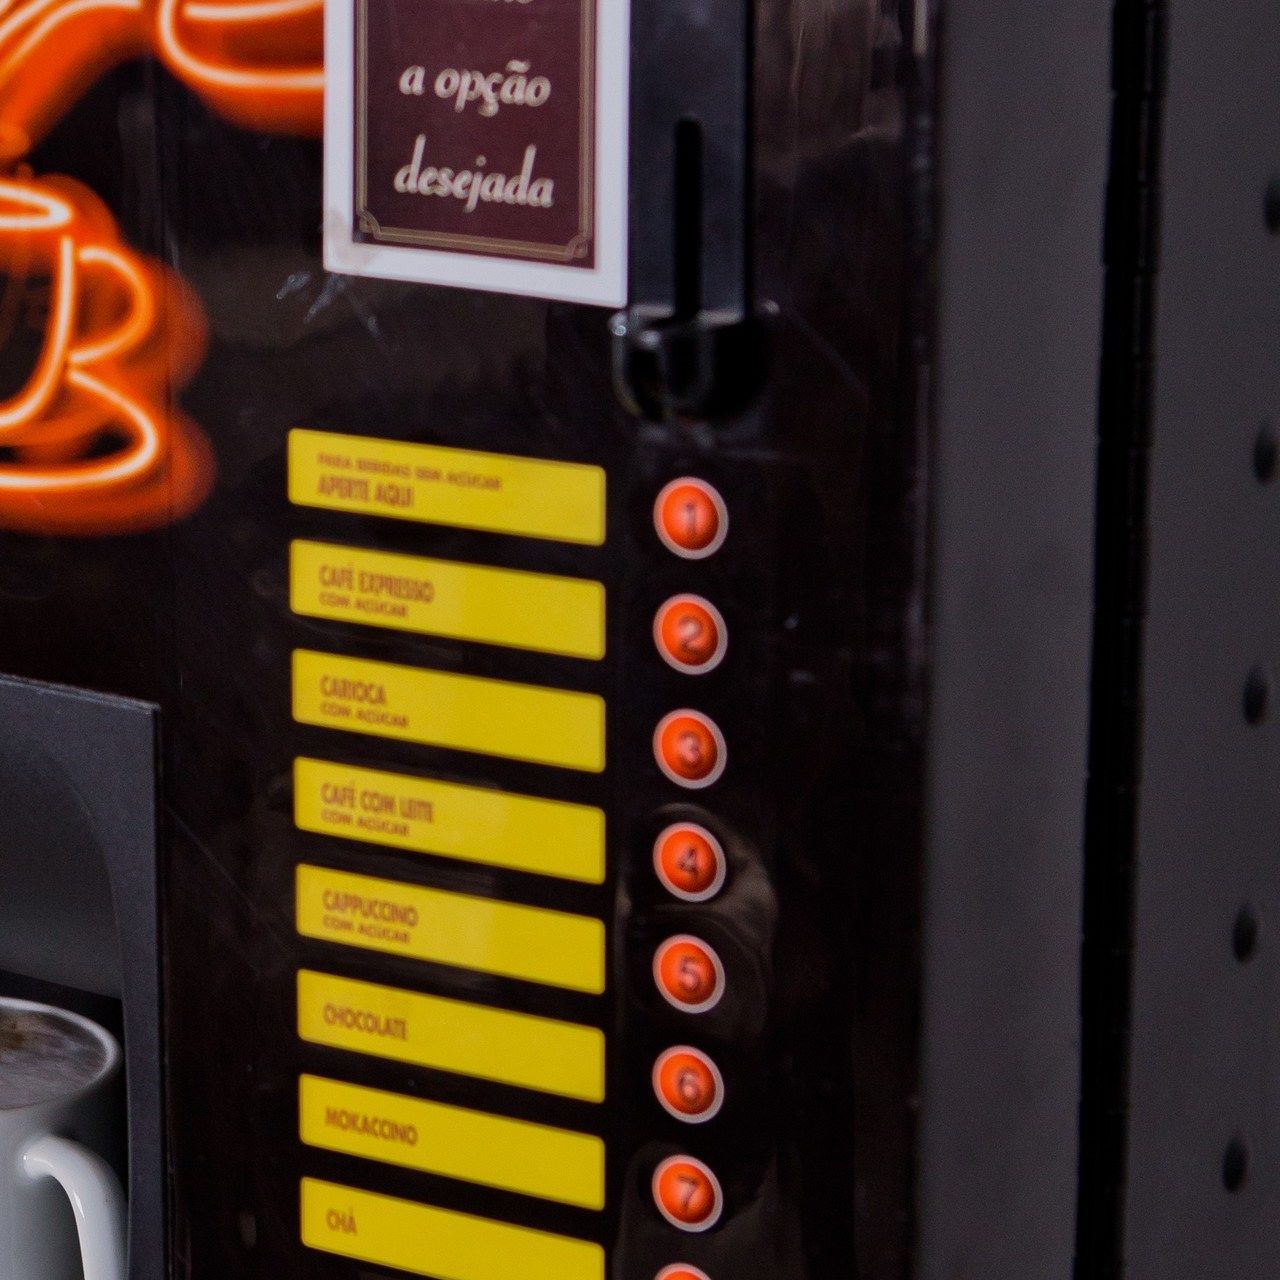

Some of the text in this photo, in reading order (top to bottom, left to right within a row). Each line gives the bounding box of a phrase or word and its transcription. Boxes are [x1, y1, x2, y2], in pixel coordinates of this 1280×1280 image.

[399, 60, 552, 118] a opção
[393, 133, 555, 213] desejada
[318, 475, 414, 507] APERTE AQUI
[684, 502, 698, 536] 1
[677, 615, 702, 652] 2
[321, 675, 386, 705] CARIOCA
[680, 730, 701, 767] 3
[361, 790, 395, 814] COM
[401, 799, 434, 823] LEITE
[677, 847, 699, 880] 4
[323, 890, 418, 927] CAPPUCCINO
[679, 955, 699, 991] 5
[324, 1002, 407, 1040] CHOCOLATE
[679, 1066, 698, 1103] 6
[326, 1107, 418, 1146] MOKACCINO
[678, 1175, 698, 1209] 7
